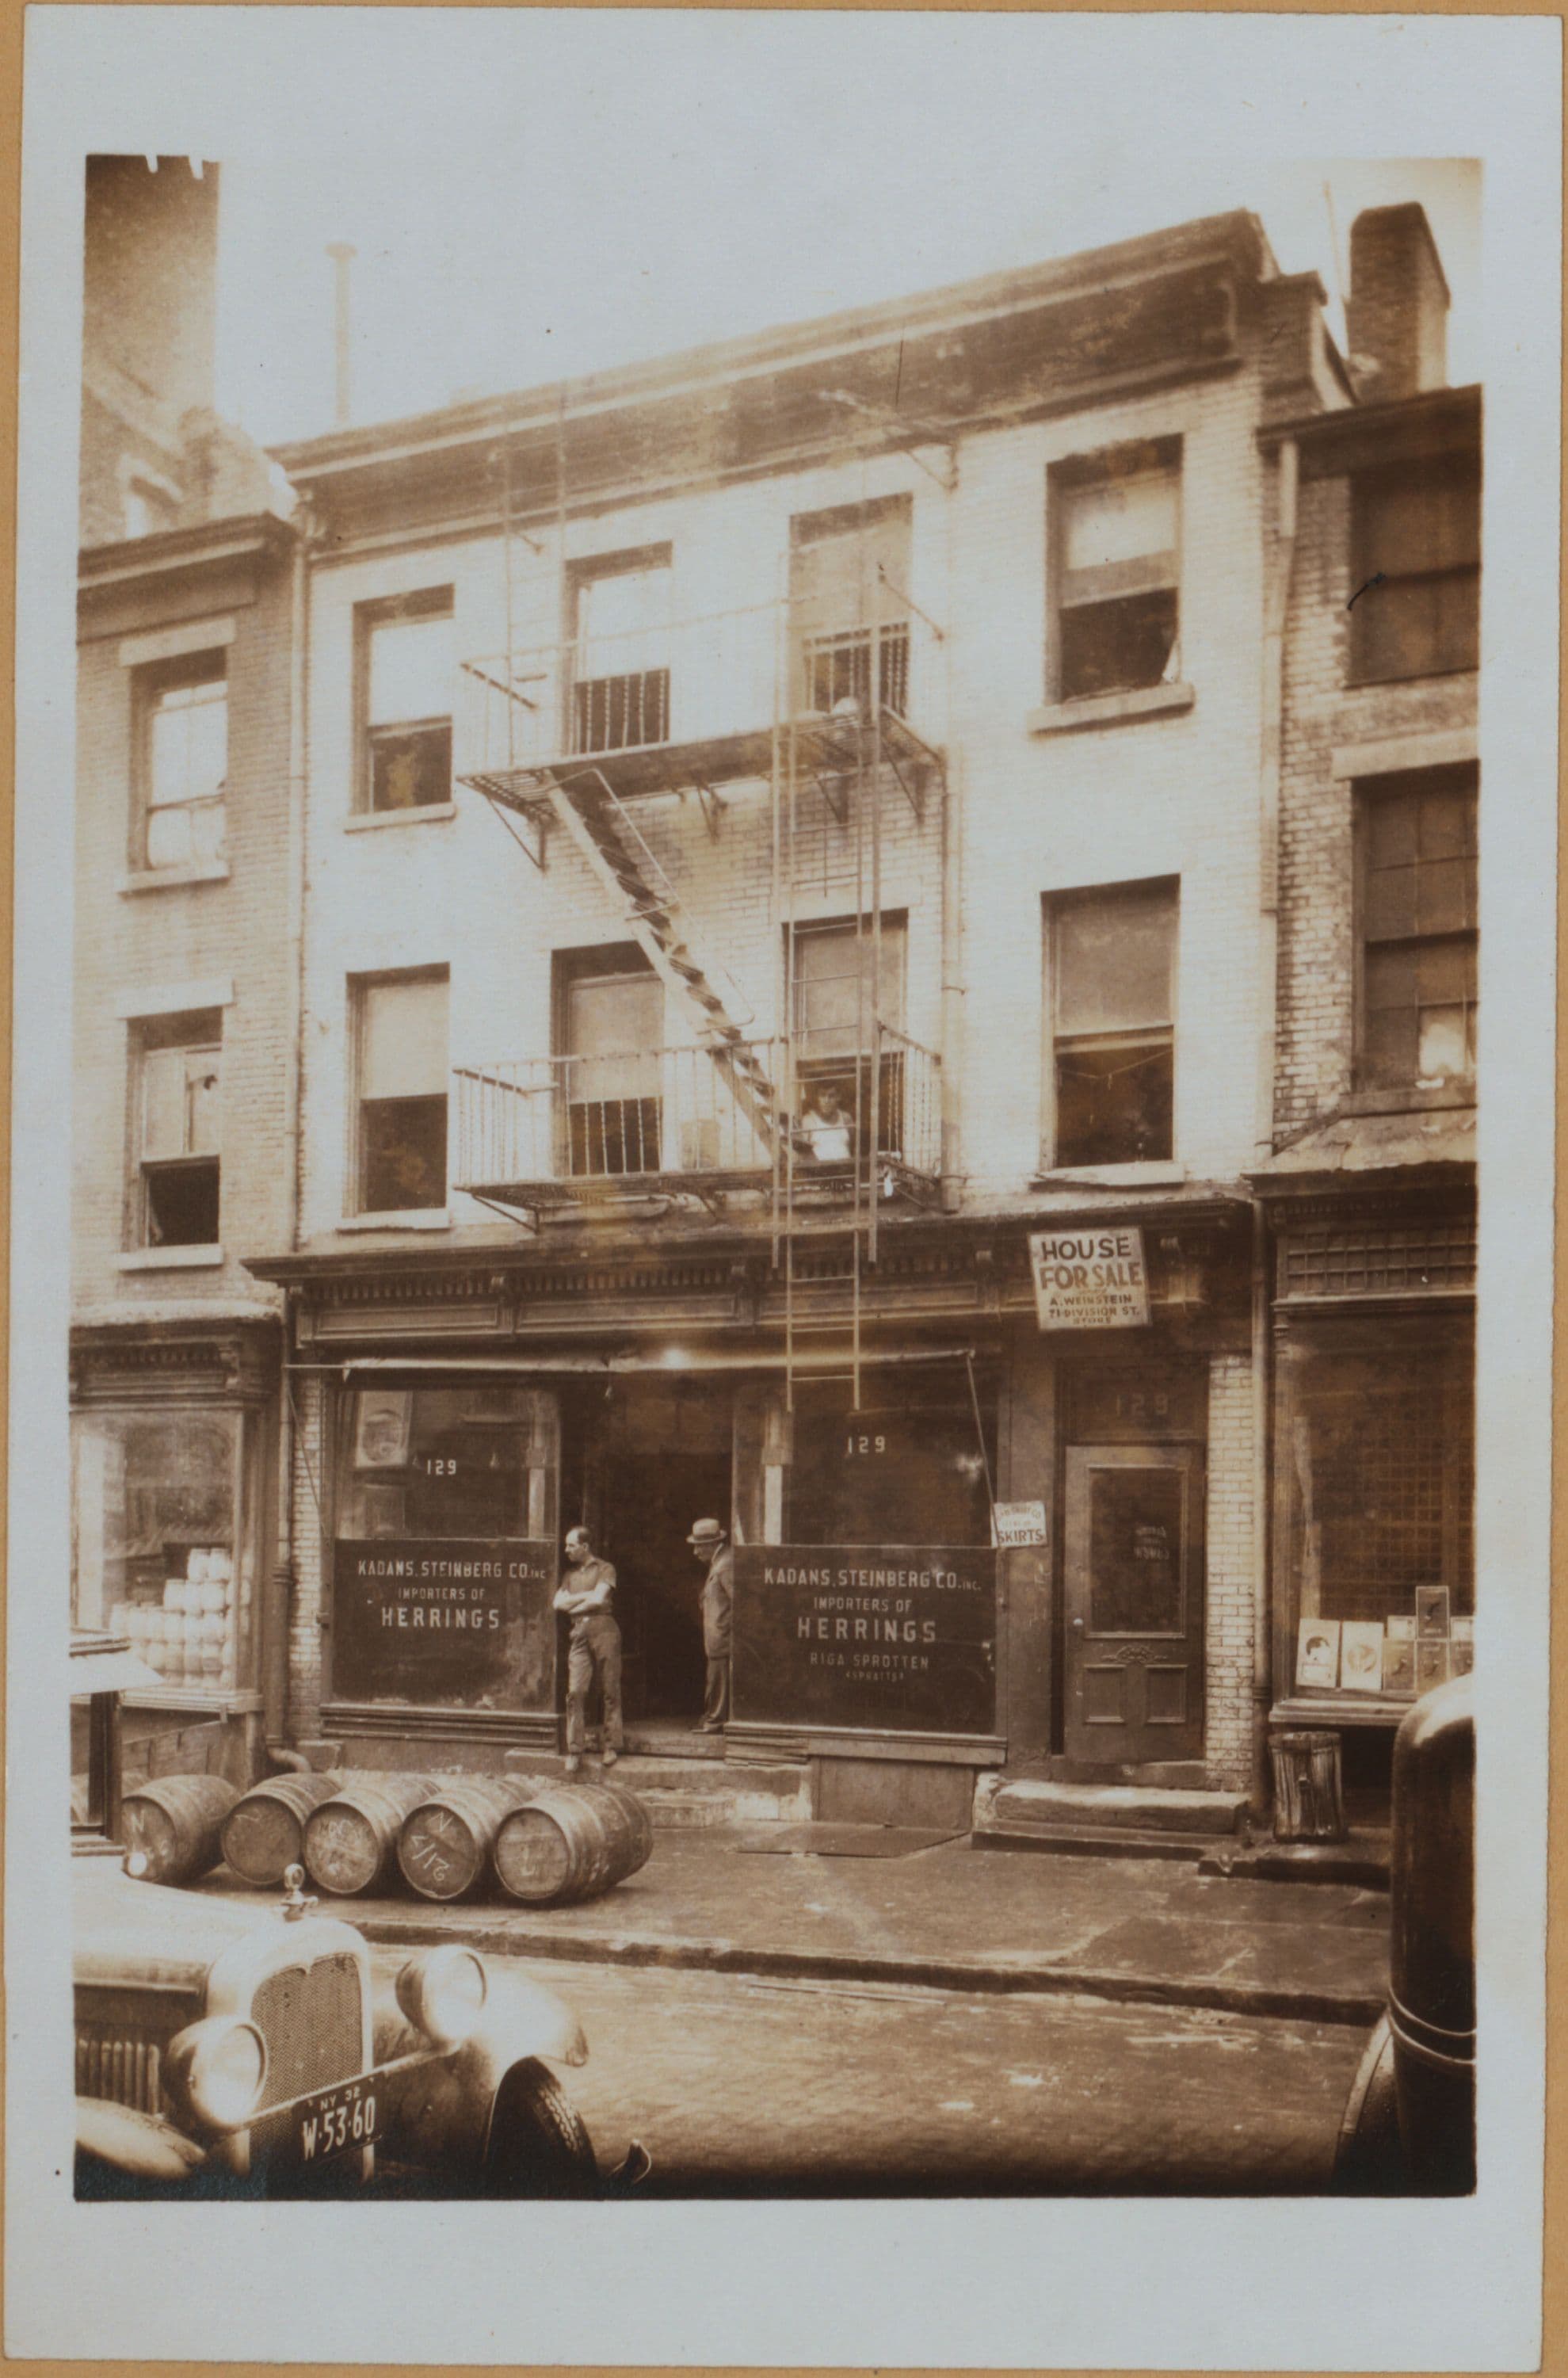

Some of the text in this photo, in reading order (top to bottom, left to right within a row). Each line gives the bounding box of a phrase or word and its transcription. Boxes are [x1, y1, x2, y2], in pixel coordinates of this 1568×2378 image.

[1041, 1237, 1131, 1262] HOUSE
[1039, 1262, 1143, 1290] FOR SALE
[1064, 1293, 1132, 1306] WEINSTEIN
[1122, 1306, 1140, 1316] ST.
[848, 1436, 886, 1454] 129
[427, 1459, 457, 1475] 129
[998, 1529, 1044, 1544] SKIRTS
[421, 1560, 502, 1578] STEINBERG
[838, 1569, 929, 1589] STEINBERG
[399, 1586, 486, 1600] IMPORTERS OF
[814, 1597, 913, 1613] IMPORTERS OF
[382, 1606, 500, 1629] HERRINGS
[797, 1617, 937, 1643] HERRINGS
[810, 1652, 929, 1670] RIGA SPROTTEN
[319, 2094, 337, 2111] NY
